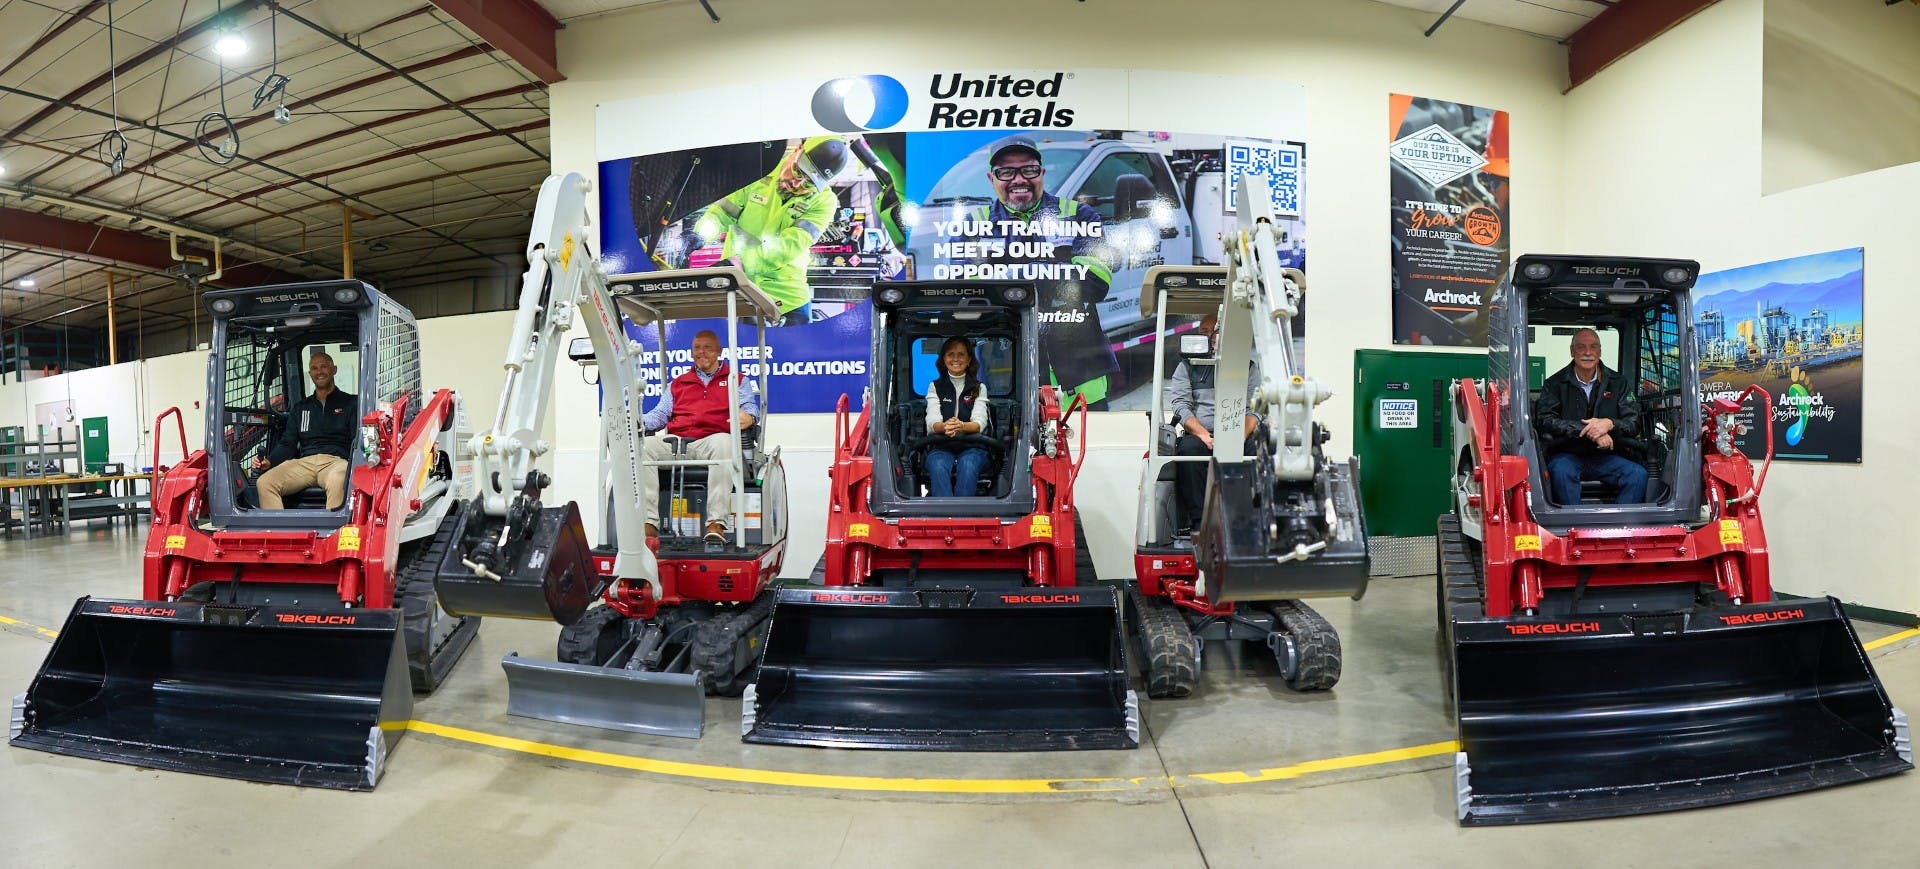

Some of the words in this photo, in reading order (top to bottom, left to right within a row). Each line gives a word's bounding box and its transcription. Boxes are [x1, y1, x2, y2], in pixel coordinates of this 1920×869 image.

[929, 72, 1064, 99] United
[928, 101, 1075, 129] Rentals
[1413, 141, 1428, 149] OUR
[1430, 143, 1450, 152] TIME
[1400, 147, 1429, 159] YOUR
[1431, 151, 1472, 164] UPTIME
[1424, 202, 1448, 212] TIME
[1449, 205, 1462, 213] TO
[933, 220, 994, 237] YOUR
[997, 220, 1101, 237] TRAINING
[1405, 228, 1428, 238] YOUR
[1428, 230, 1462, 240] CAREER!
[1469, 220, 1497, 234] GROWTH
[933, 242, 1005, 259] MEETS
[1008, 241, 1055, 258] OUR
[933, 263, 1089, 281] OPPORTUNITY
[1423, 288, 1481, 305] Archrock
[1037, 309, 1084, 323] entals
[772, 360, 866, 376] LOCATIONS
[1383, 402, 1414, 410] NOTICE
[1778, 392, 1824, 407] Archrock
[1771, 405, 1836, 422] Sustainability
